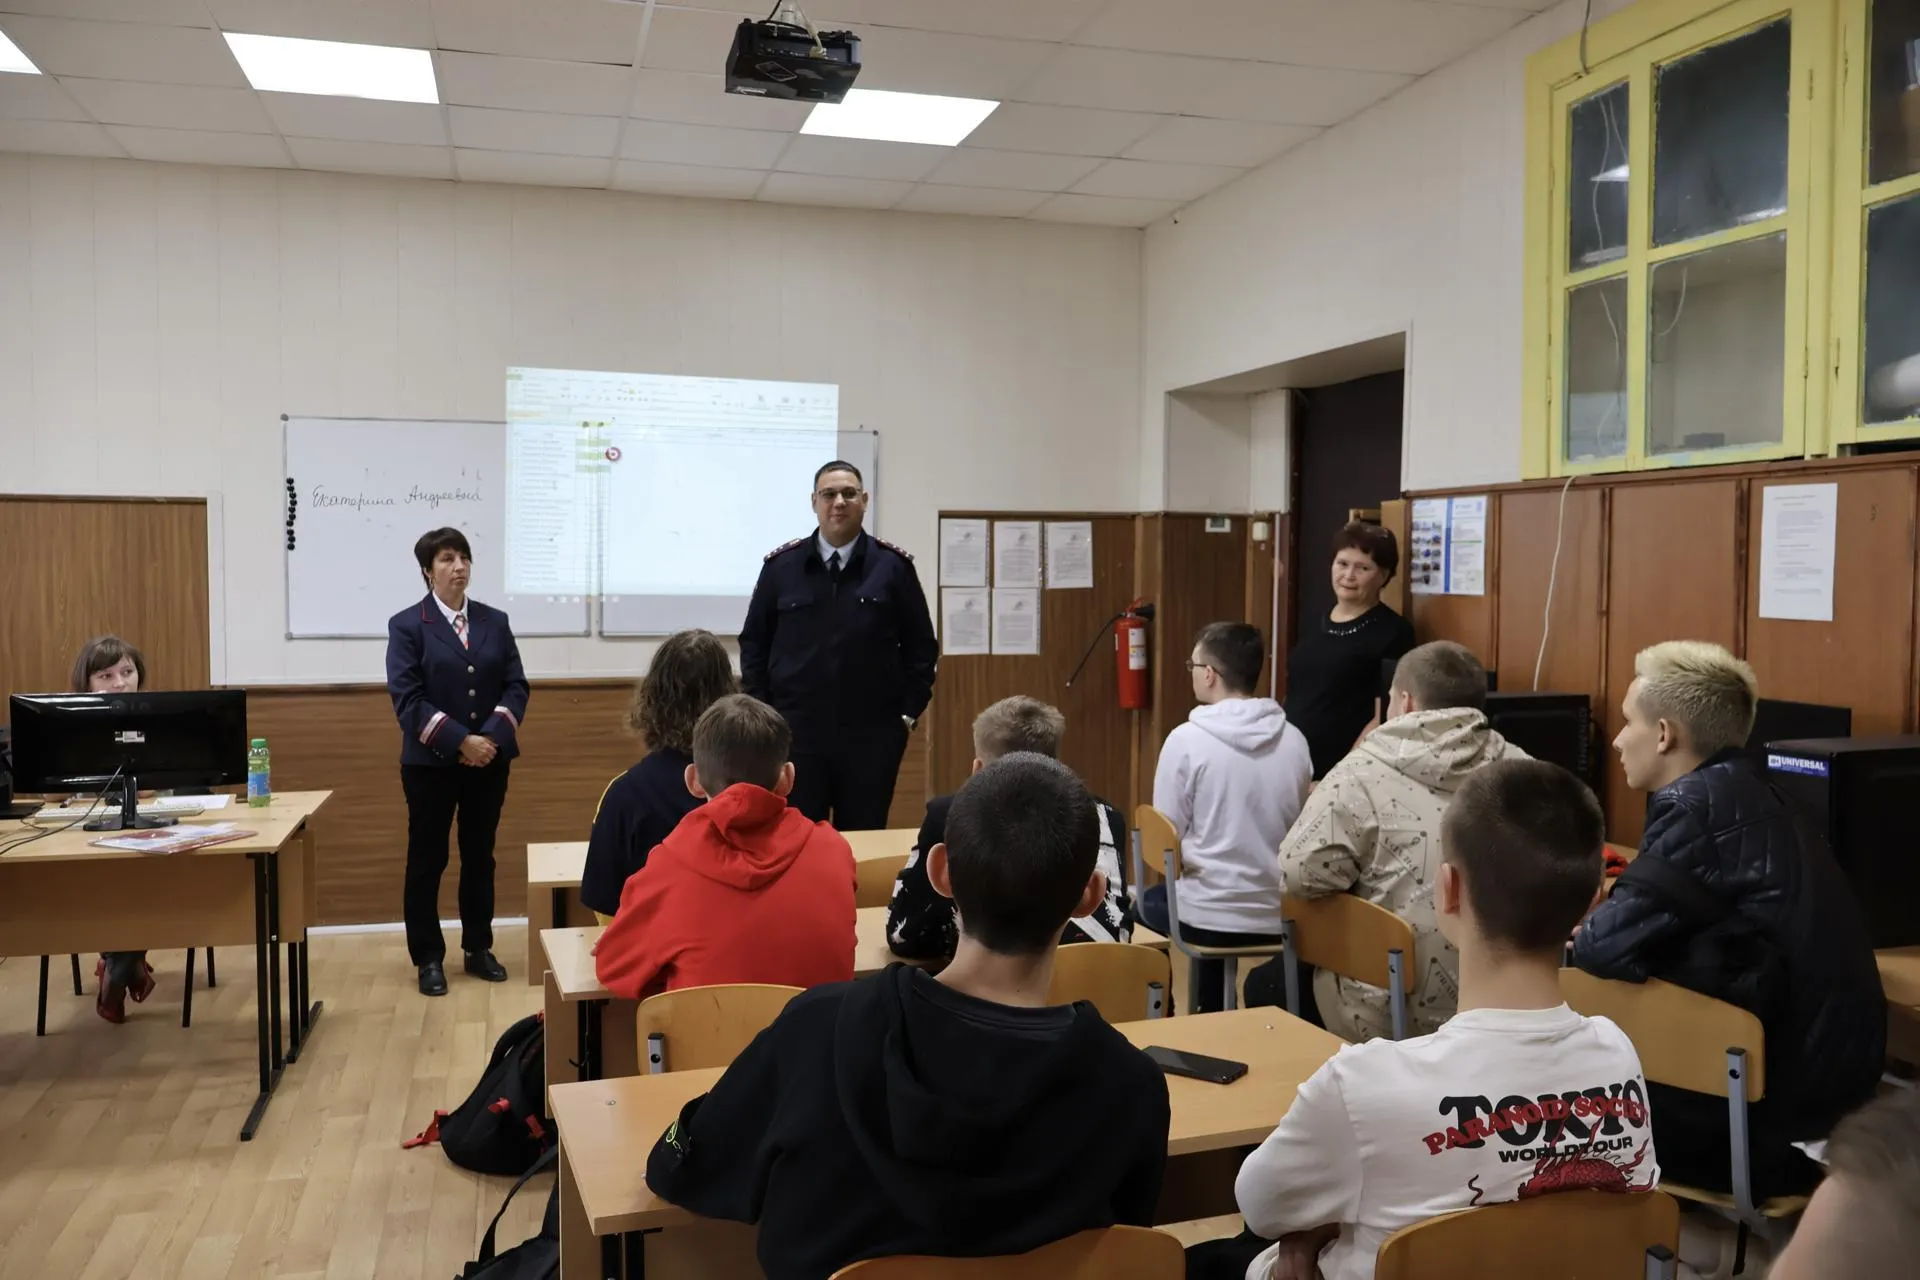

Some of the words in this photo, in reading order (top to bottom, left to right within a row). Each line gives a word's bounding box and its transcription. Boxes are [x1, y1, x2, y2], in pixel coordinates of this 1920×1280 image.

[312, 484, 396, 511] Екатерина
[1781, 755, 1825, 771] UNIVERSAL
[1422, 1098, 1571, 1155] PARANOID
[1438, 1079, 1644, 1149] TOKYO
[1498, 1143, 1580, 1163] WORLD
[1580, 1136, 1633, 1154] TOUR
